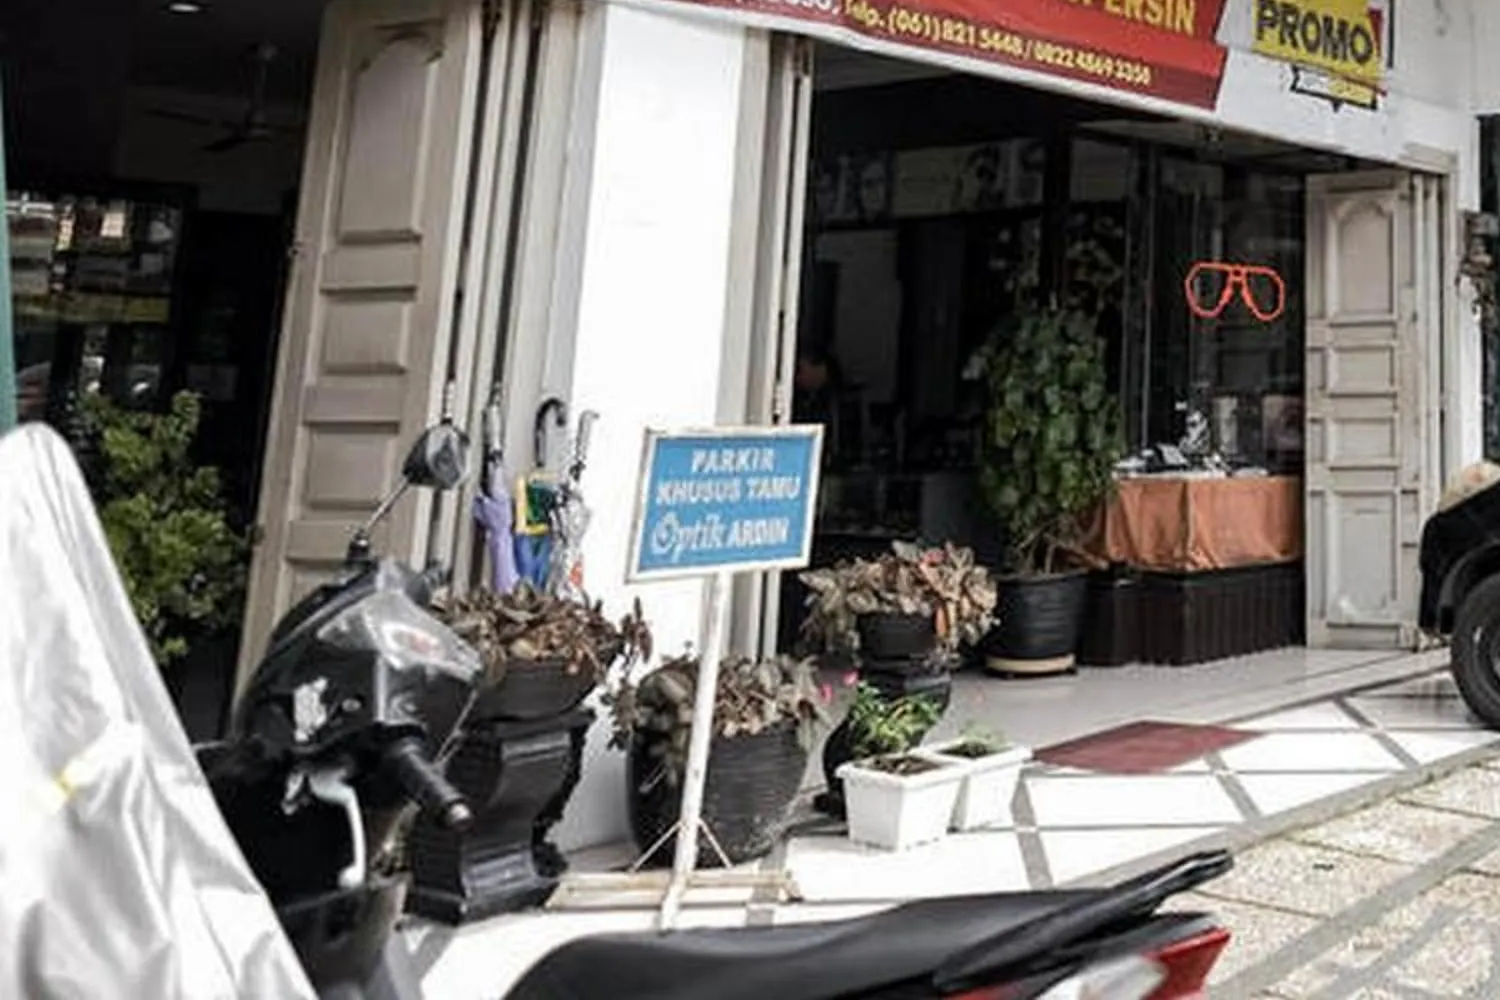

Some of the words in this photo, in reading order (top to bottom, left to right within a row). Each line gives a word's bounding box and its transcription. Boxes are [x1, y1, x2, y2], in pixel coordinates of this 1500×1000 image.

[691, 447, 775, 473] PARKIR
[656, 477, 741, 505] KHUSUS
[747, 475, 801, 500] TAMU
[651, 510, 726, 563] Optik
[726, 517, 790, 548] ARDIN
